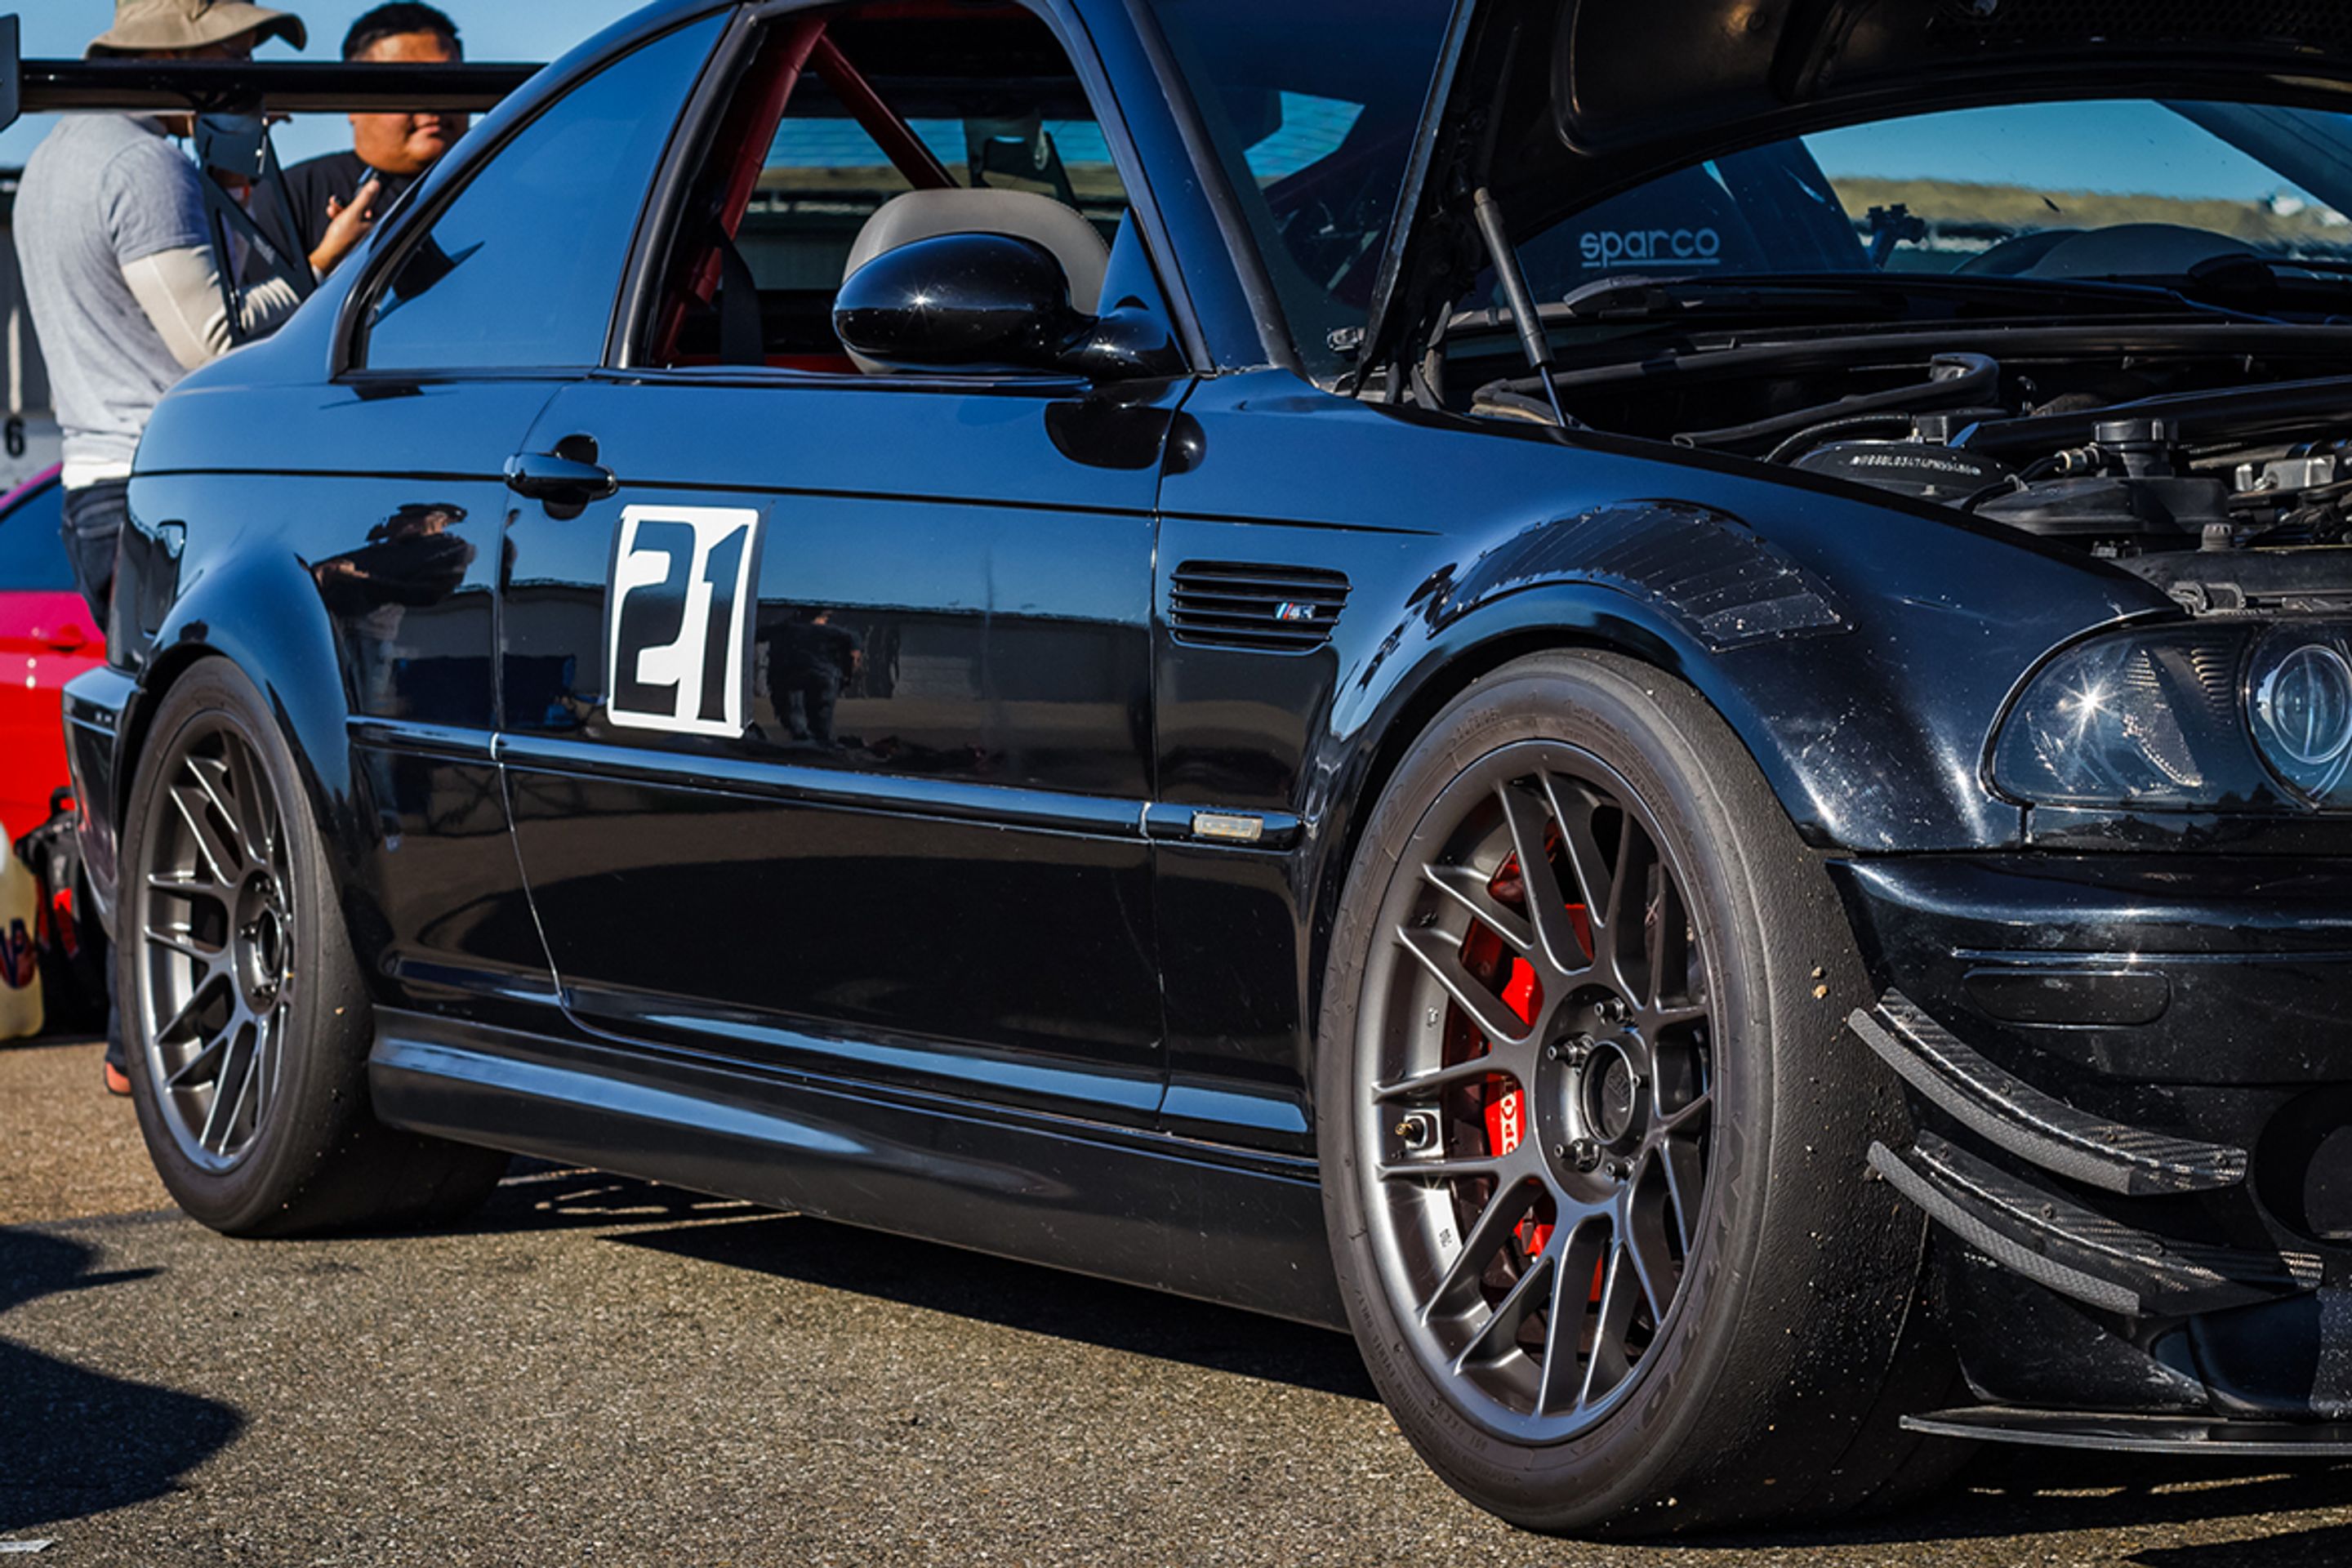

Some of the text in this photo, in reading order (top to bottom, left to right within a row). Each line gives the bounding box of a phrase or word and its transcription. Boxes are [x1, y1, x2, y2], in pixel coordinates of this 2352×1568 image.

[1579, 228, 1720, 268] sparco
[4, 416, 25, 459] 6
[612, 520, 749, 722] 21
